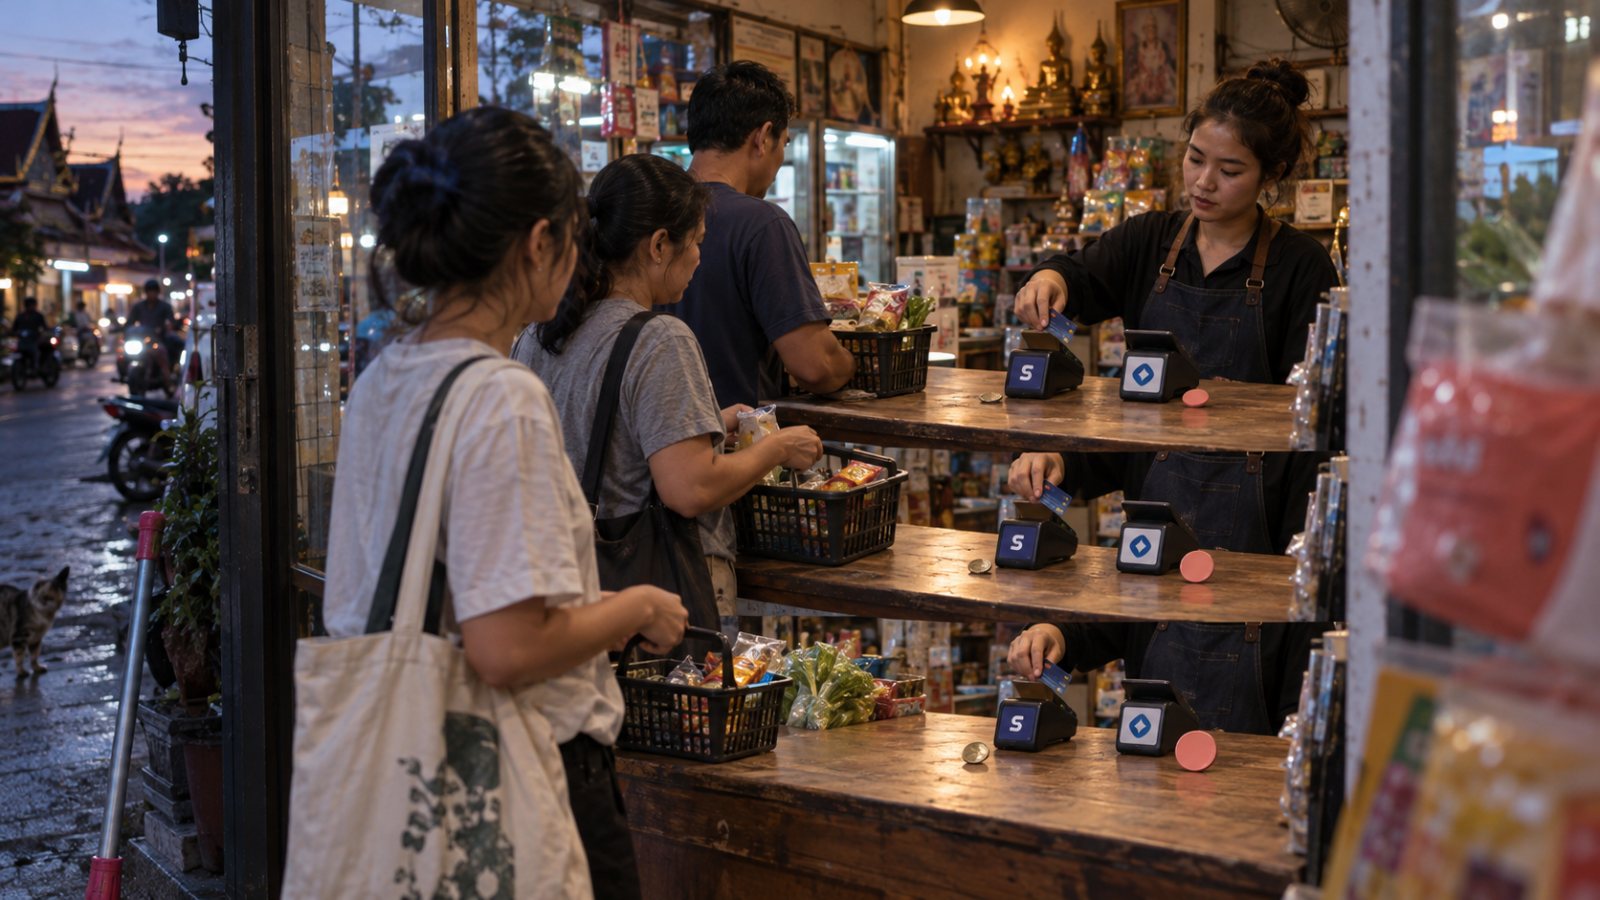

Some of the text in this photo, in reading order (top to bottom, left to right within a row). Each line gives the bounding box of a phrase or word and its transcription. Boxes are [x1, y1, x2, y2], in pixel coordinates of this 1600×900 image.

[1019, 364, 1034, 381] S
[1010, 534, 1024, 551] S
[1009, 715, 1024, 732] S
